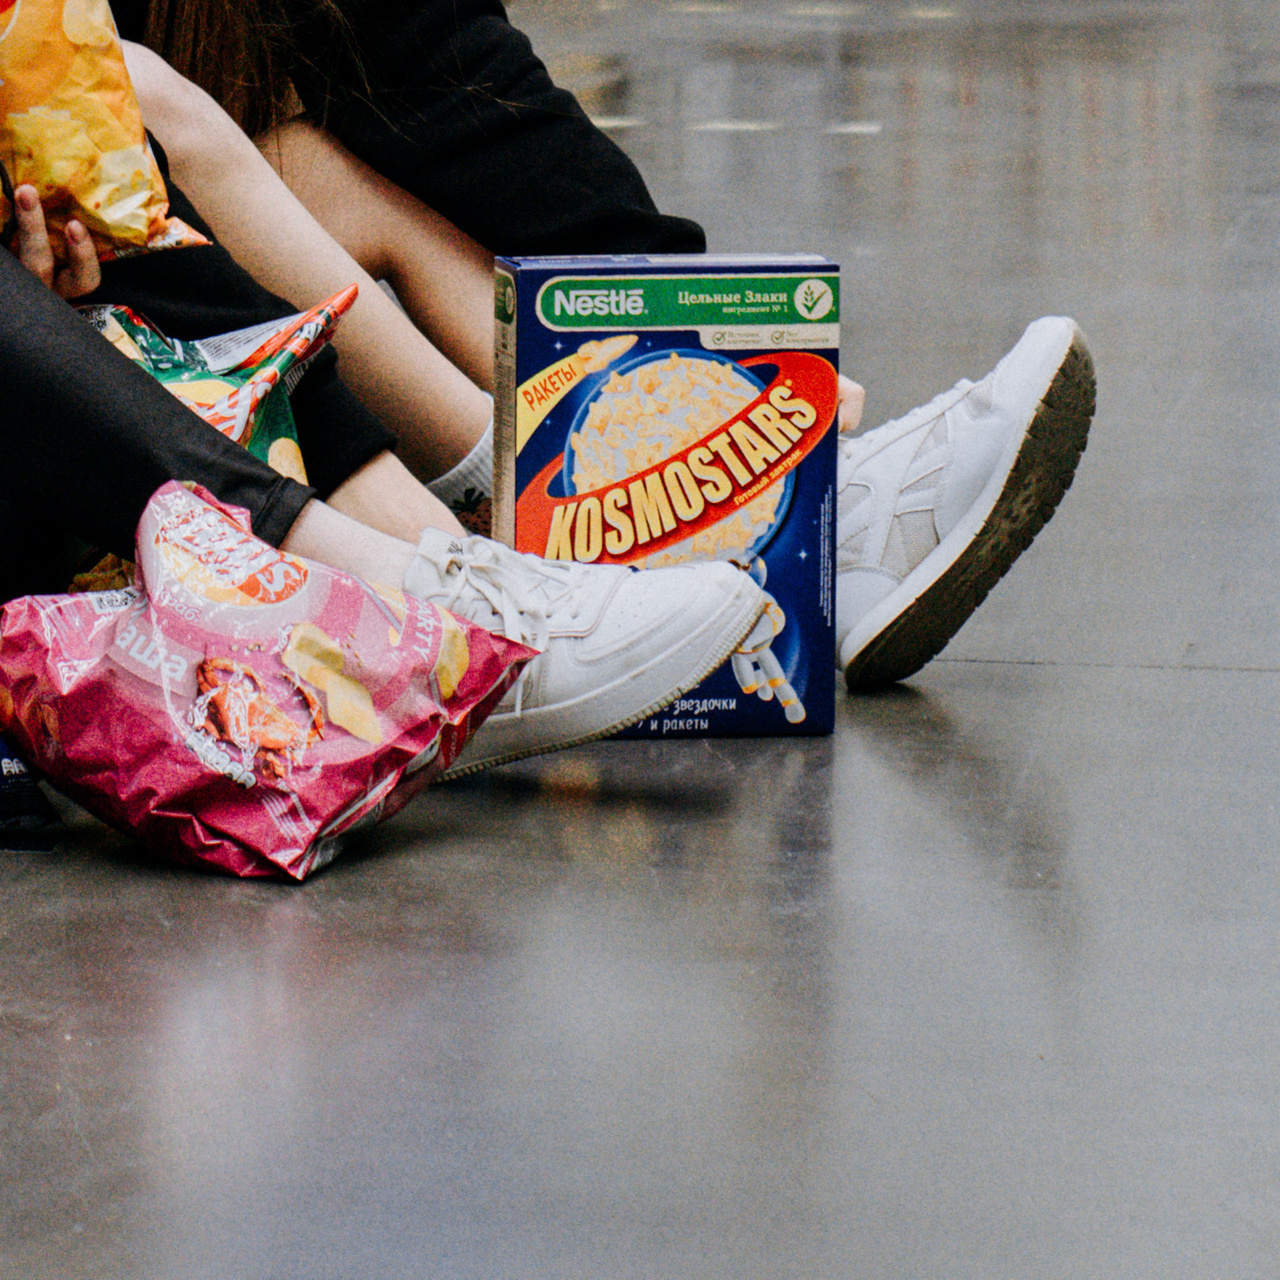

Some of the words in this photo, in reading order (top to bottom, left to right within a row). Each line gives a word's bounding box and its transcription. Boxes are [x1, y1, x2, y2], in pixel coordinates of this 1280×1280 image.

[677, 290, 741, 306] Цельные
[745, 290, 788, 304] Злаки
[522, 363, 578, 412] РАКЕТЫ
[544, 385, 818, 564] KOSMOSTARS
[768, 448, 804, 480] завтрак
[673, 698, 737, 716] звездочки
[650, 719, 658, 731] и
[662, 719, 709, 734] ракеты
